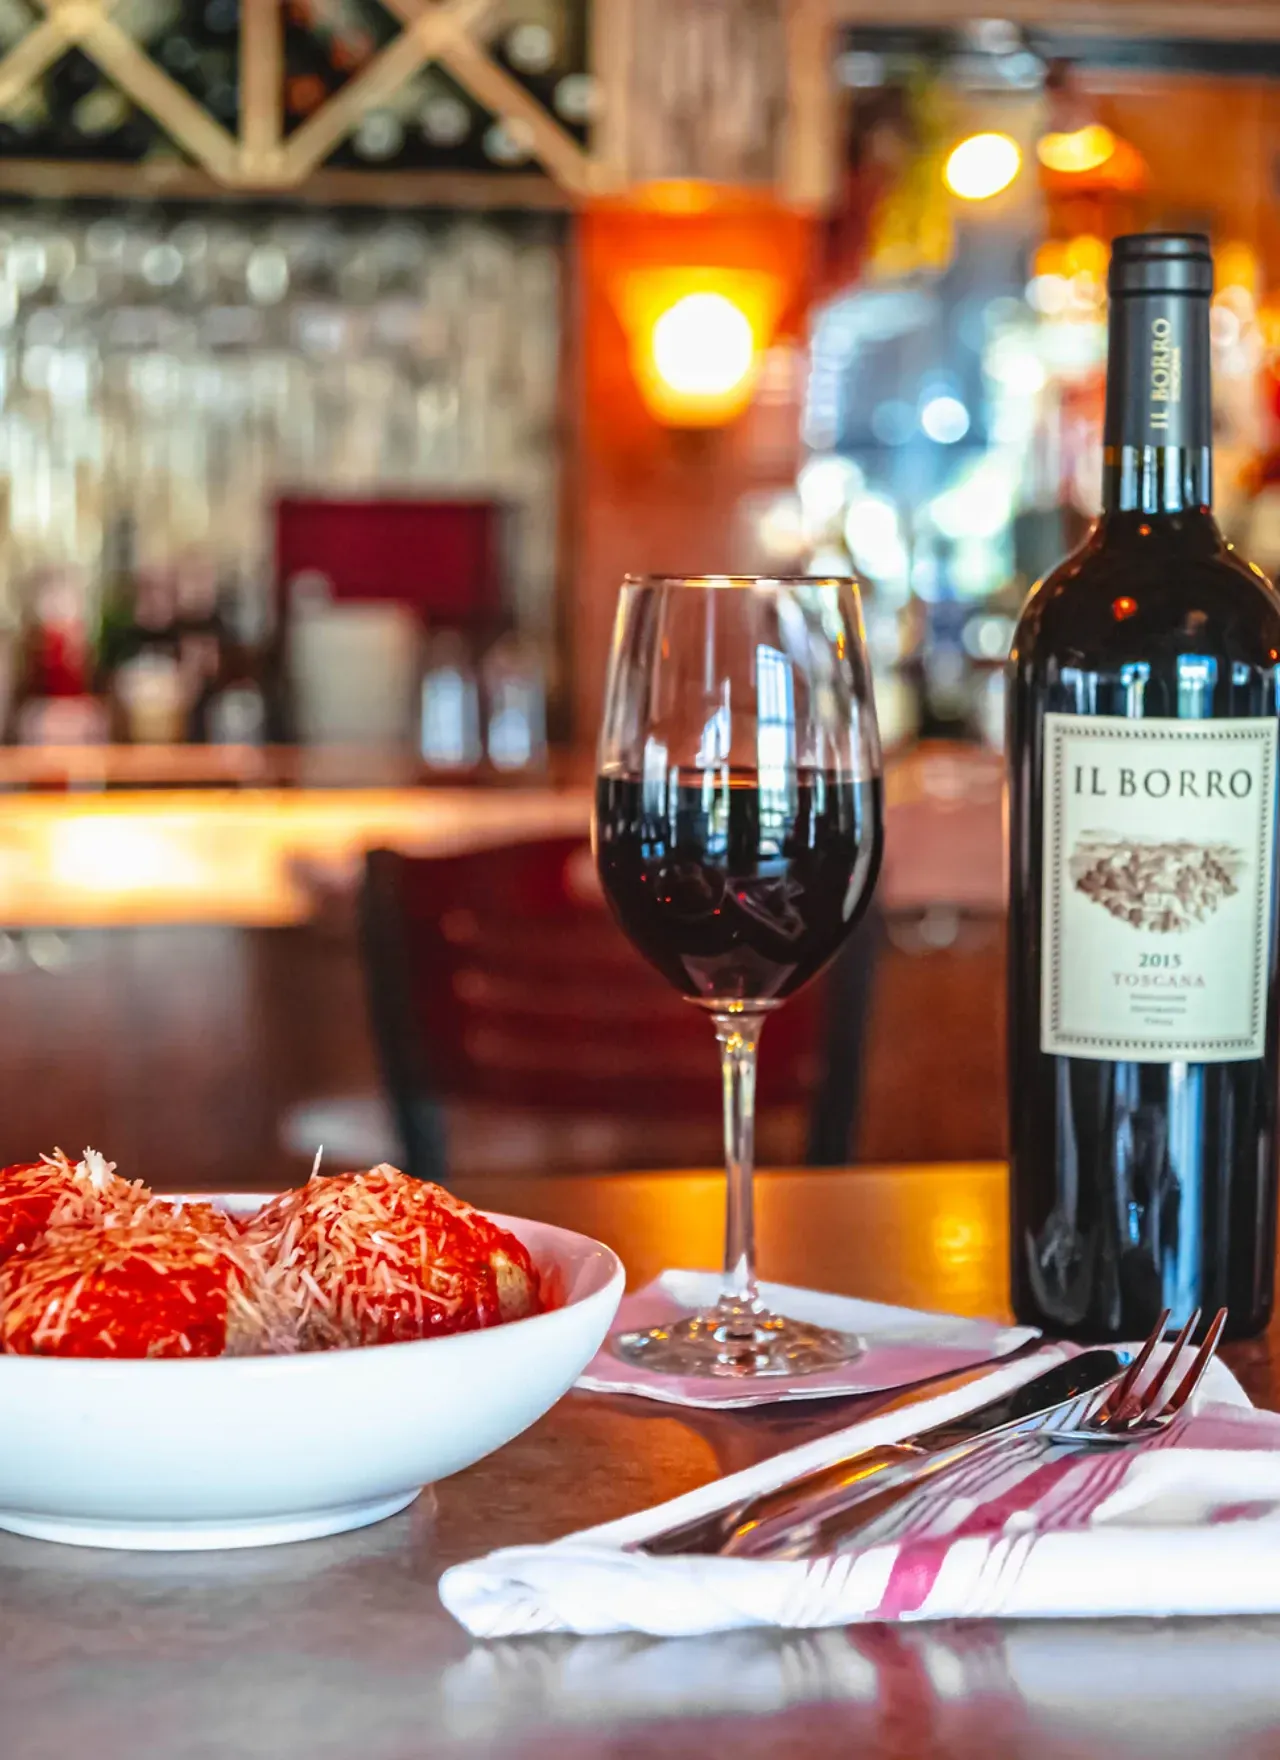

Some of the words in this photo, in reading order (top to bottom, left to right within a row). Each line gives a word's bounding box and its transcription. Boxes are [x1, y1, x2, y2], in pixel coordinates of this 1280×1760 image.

[1151, 318, 1171, 402] BORRO
[1150, 412, 1169, 428] IL
[1074, 766, 1106, 795] IL
[1119, 768, 1253, 798] BORRO
[1138, 952, 1182, 968] 2015
[1112, 972, 1206, 988] TOSCANA
